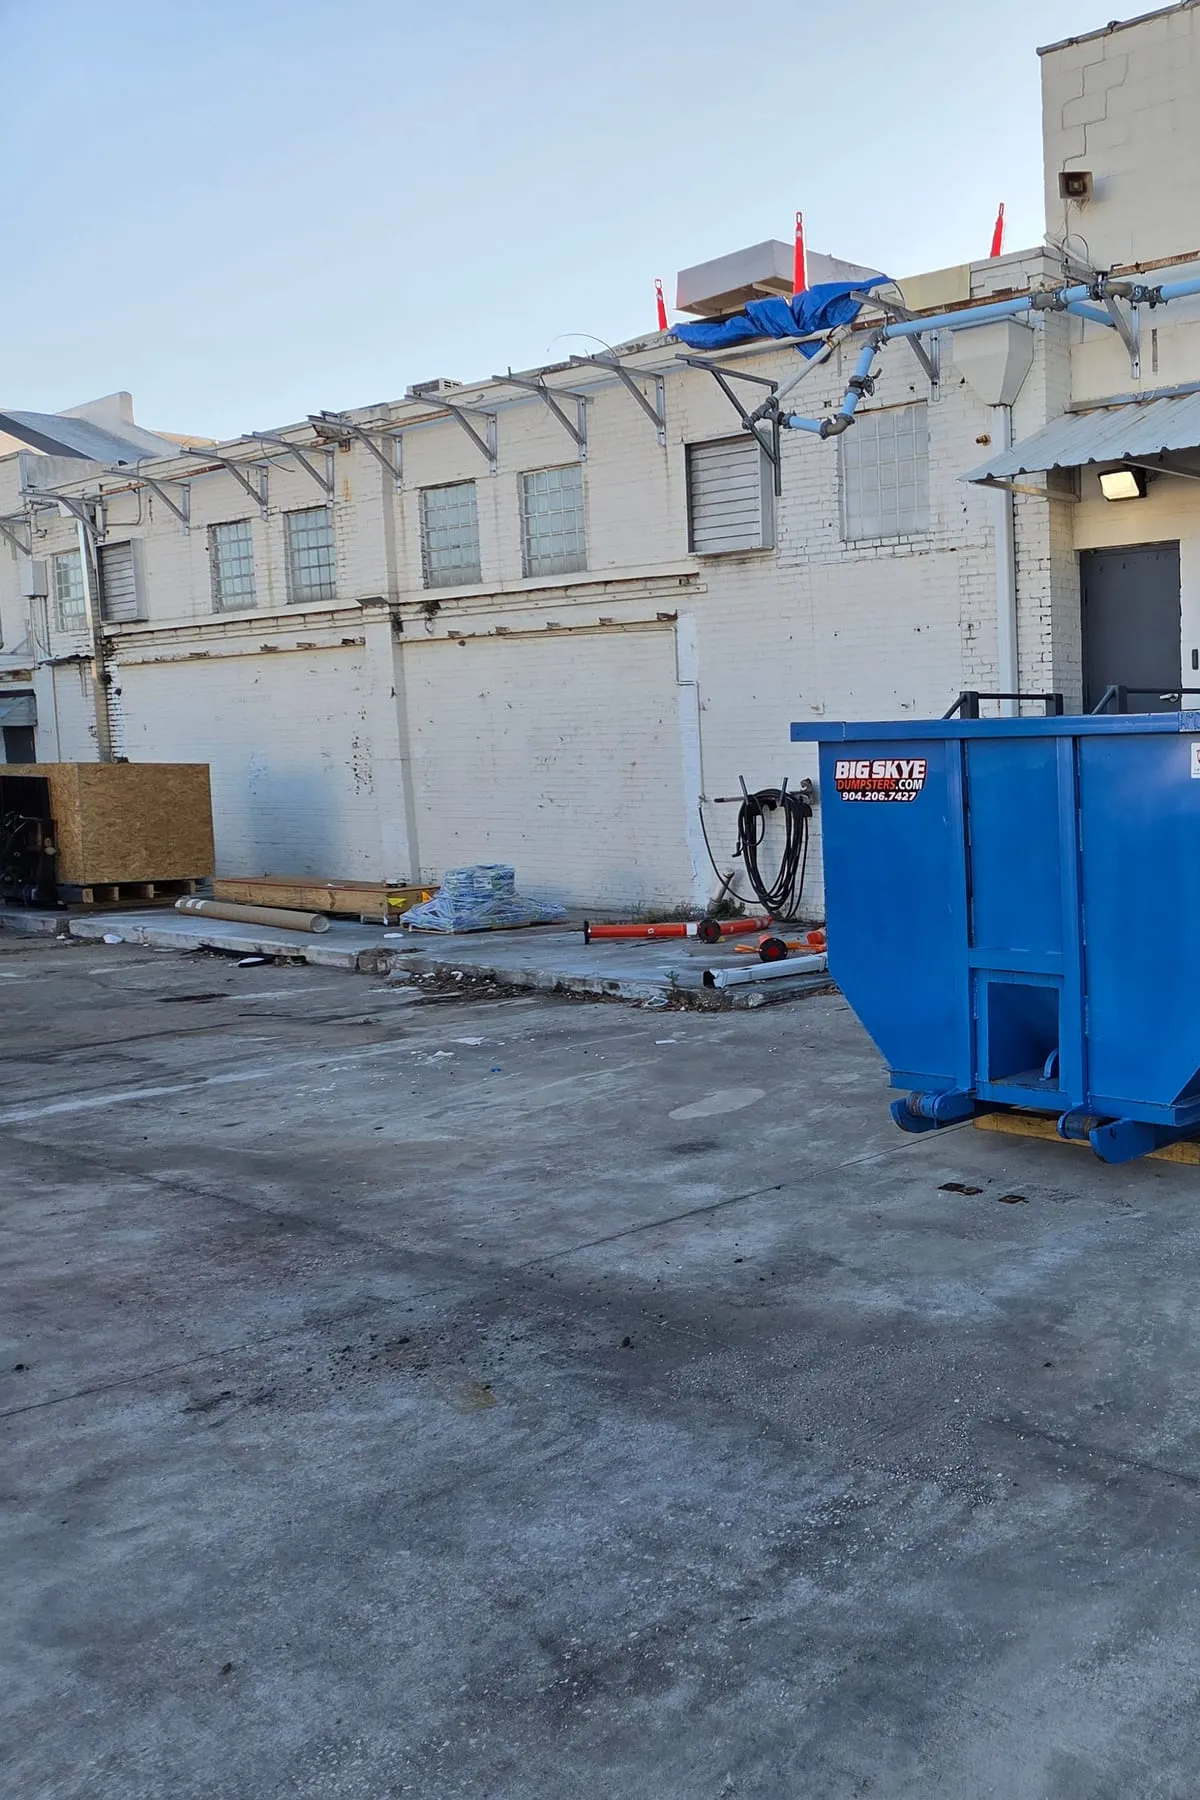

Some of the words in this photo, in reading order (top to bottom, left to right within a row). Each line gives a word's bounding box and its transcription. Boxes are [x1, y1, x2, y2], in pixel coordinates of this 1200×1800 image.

[835, 761, 870, 779] BIG
[871, 760, 926, 779] SKYE
[837, 779, 923, 790] DUMPSTERS.COM
[842, 791, 917, 801] 904.206.7427
